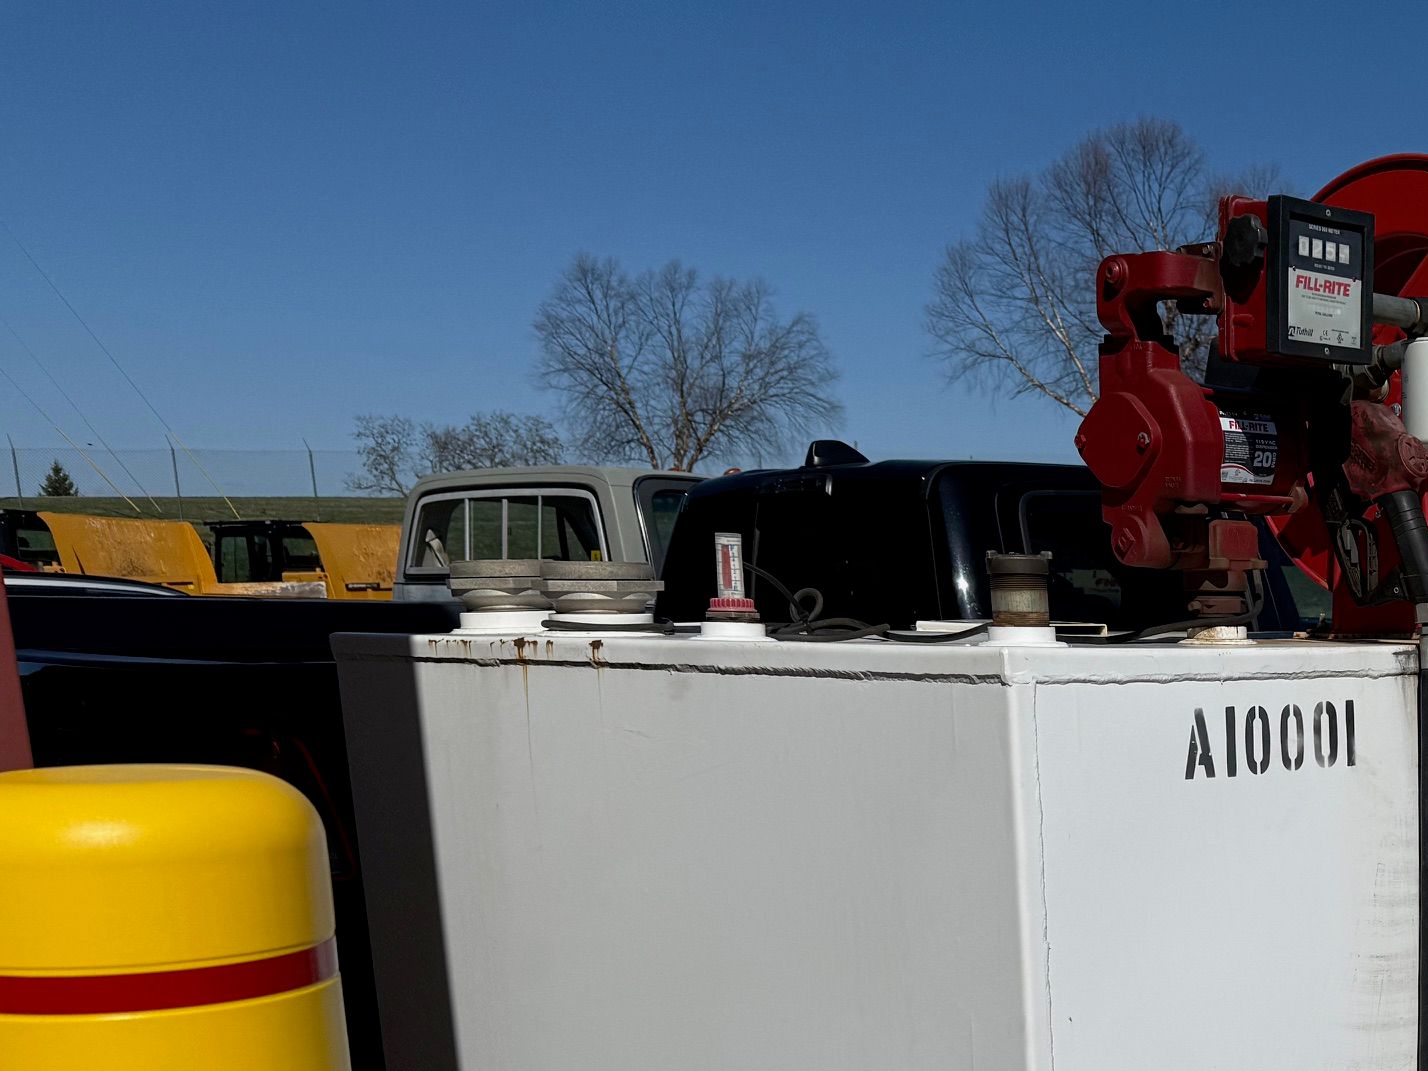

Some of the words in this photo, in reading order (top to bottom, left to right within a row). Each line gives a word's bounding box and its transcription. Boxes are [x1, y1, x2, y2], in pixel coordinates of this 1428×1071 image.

[1295, 274, 1351, 297] FILL-RITE
[1229, 420, 1268, 433] FILL-RITE
[1253, 451, 1271, 467] 20
